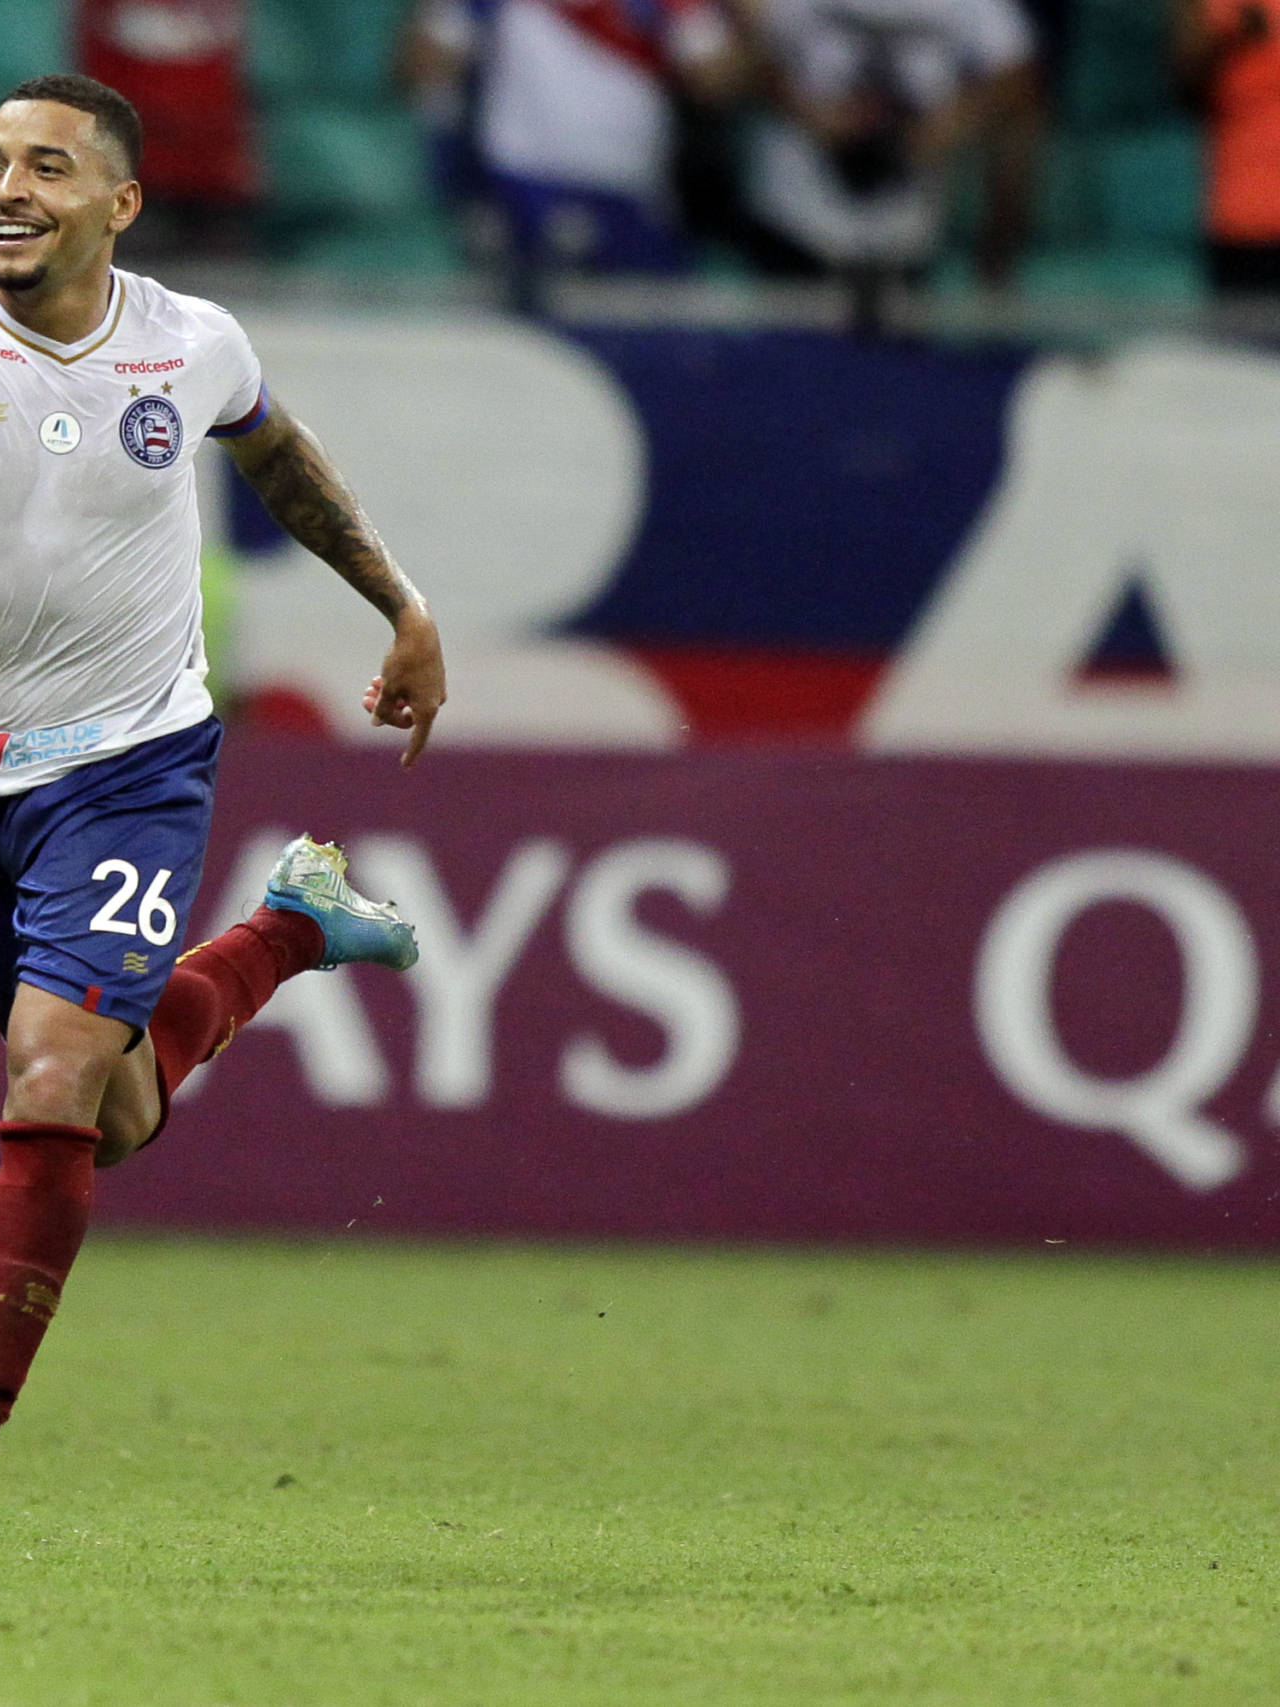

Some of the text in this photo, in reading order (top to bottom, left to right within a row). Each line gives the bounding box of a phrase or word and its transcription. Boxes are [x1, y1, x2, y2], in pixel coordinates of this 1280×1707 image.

[114, 358, 184, 374] credcesta
[9, 721, 104, 749] CASA DE
[89, 859, 177, 946] 26
[973, 846, 1280, 1192] Q
